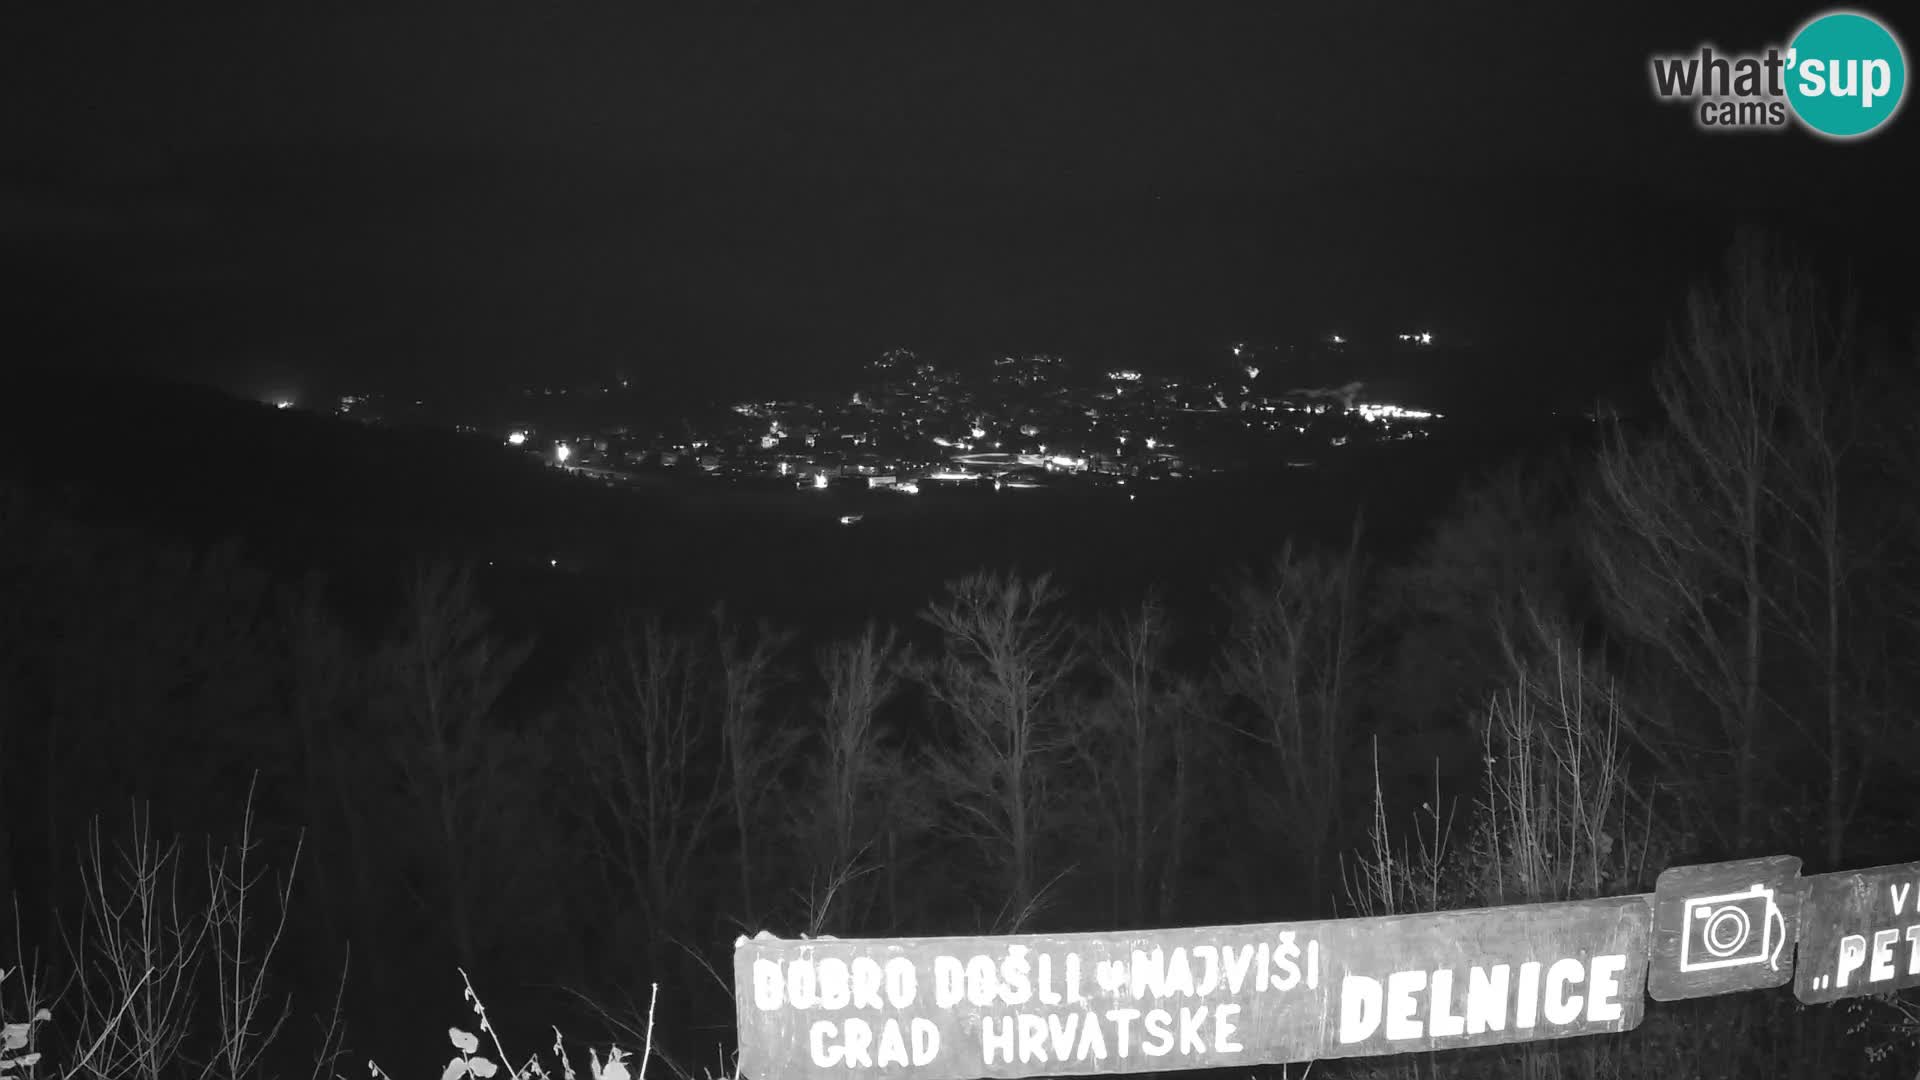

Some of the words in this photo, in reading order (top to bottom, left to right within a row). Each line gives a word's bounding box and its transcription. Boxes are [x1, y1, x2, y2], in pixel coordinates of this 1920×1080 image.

[752, 957, 918, 1011] DOBRO
[934, 945, 1085, 1008] DOŠLI
[1131, 931, 1319, 999] NAJVIŠI
[1341, 954, 1626, 1044] DELNICE
[809, 1018, 941, 1069] GRAD
[982, 1004, 1243, 1065] HRVATSKE
